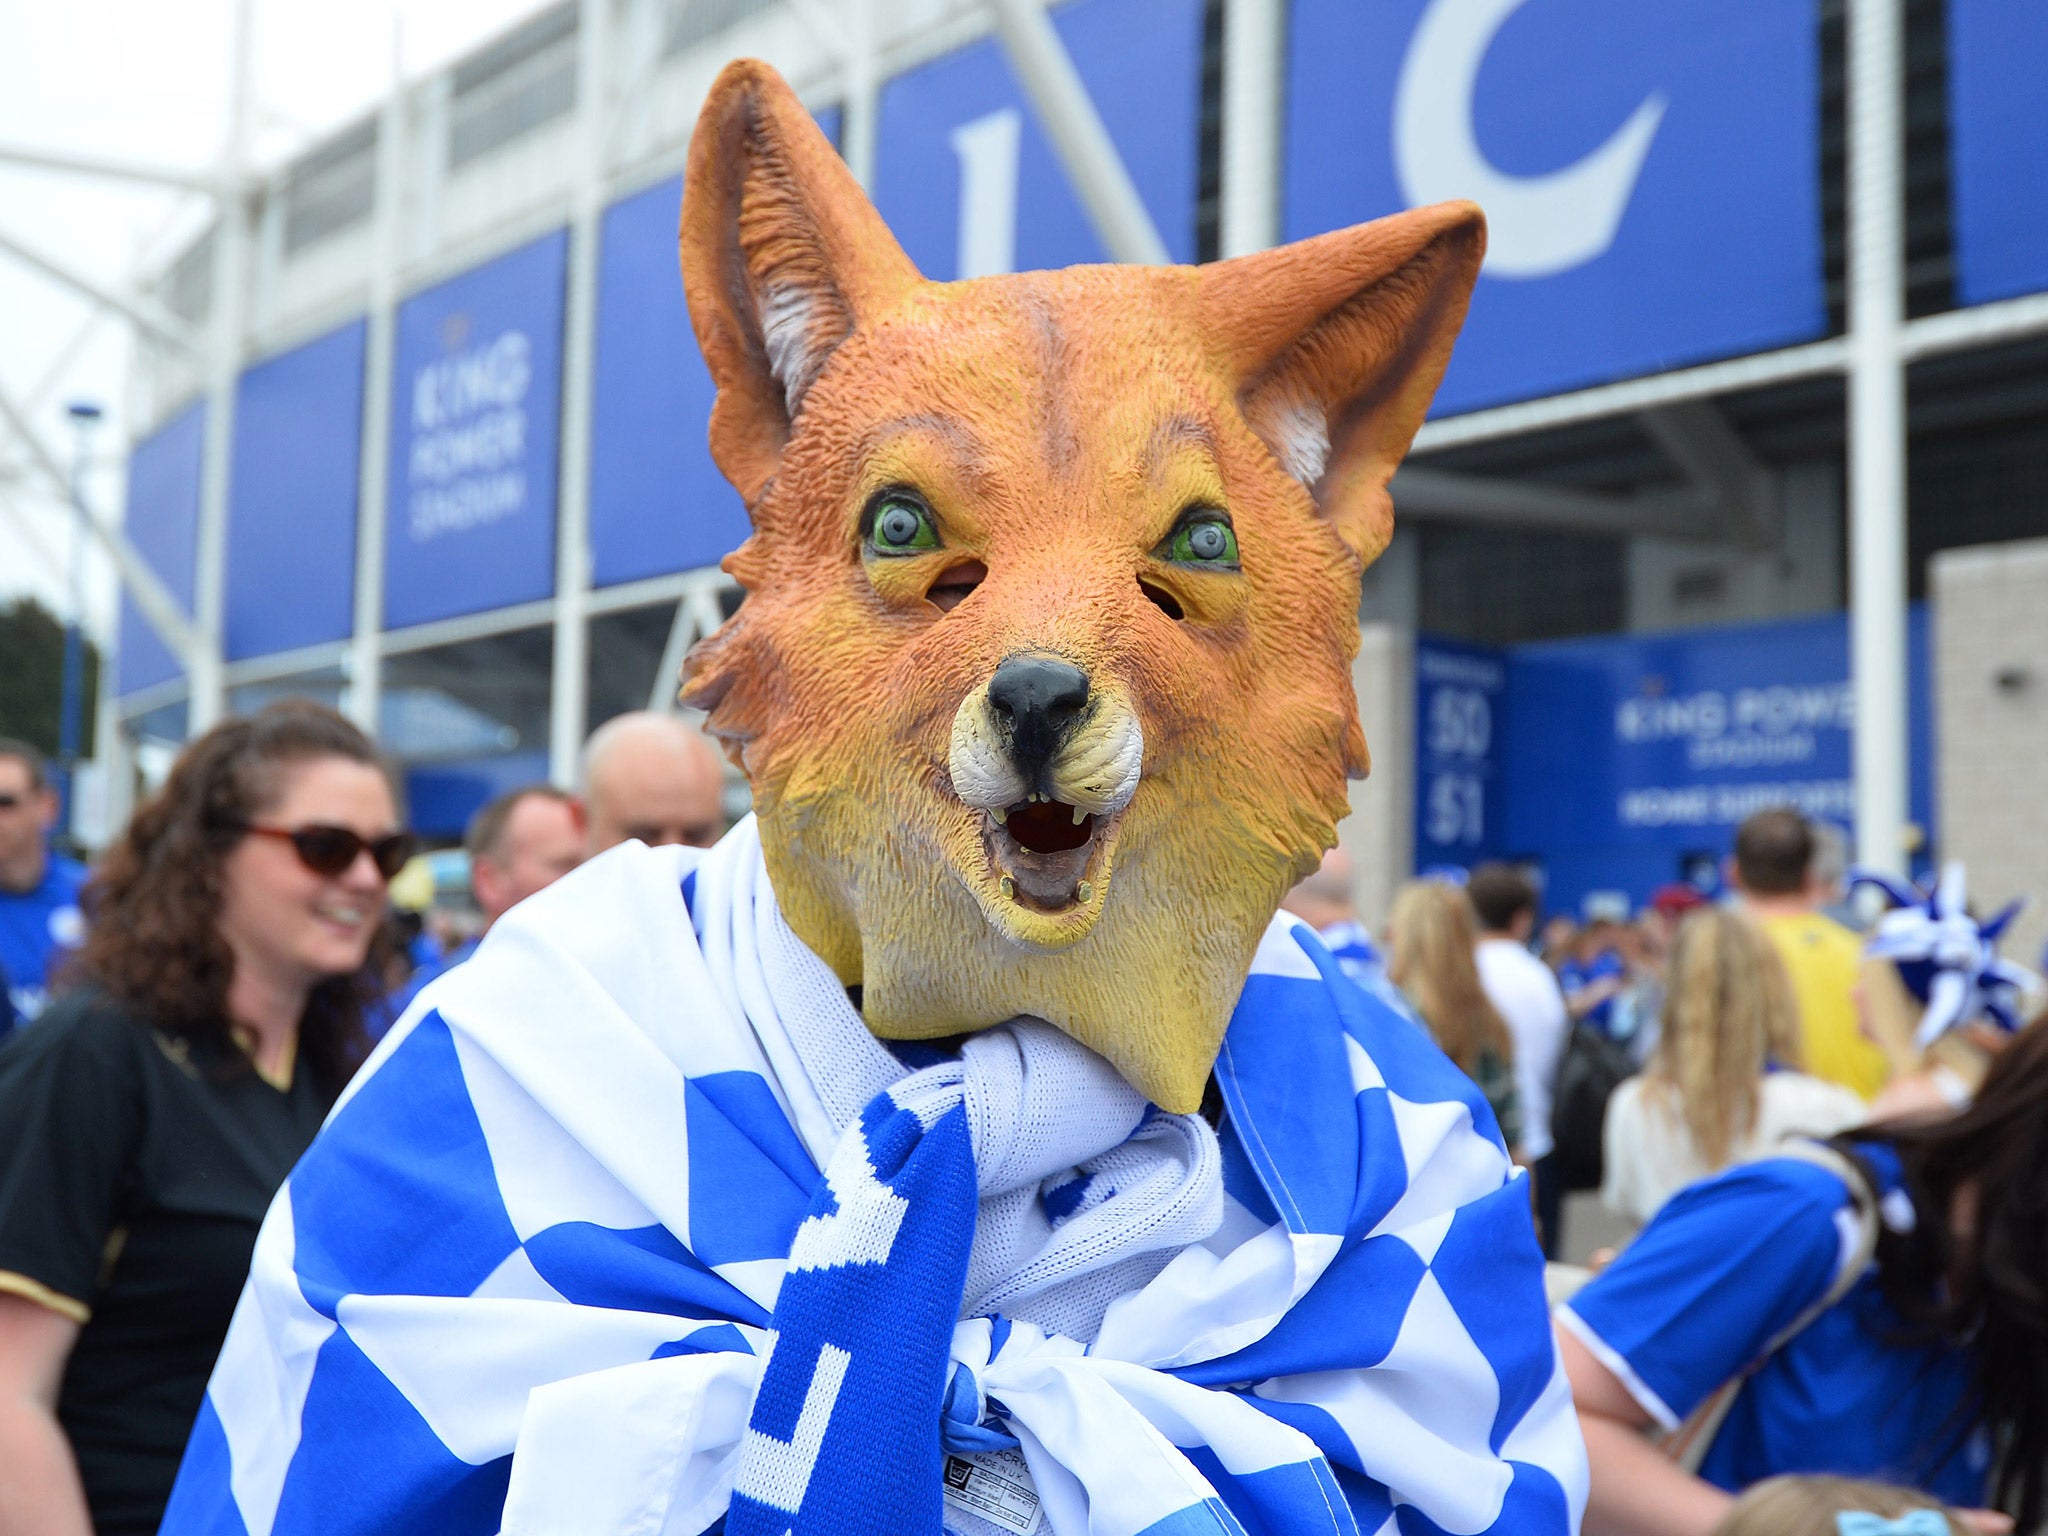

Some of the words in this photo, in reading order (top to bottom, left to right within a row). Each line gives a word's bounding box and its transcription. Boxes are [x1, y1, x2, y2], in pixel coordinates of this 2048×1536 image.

[414, 331, 530, 428] KING
[410, 404, 524, 486] POWER
[1429, 688, 1491, 757] 50
[1617, 692, 1727, 741] KING
[1736, 682, 1856, 735] POWE
[1715, 778, 1857, 823] SUPPORT
[974, 1454, 996, 1469] MADE
[998, 1464, 1007, 1474] IN
[996, 1449, 1031, 1473] ACRYL
